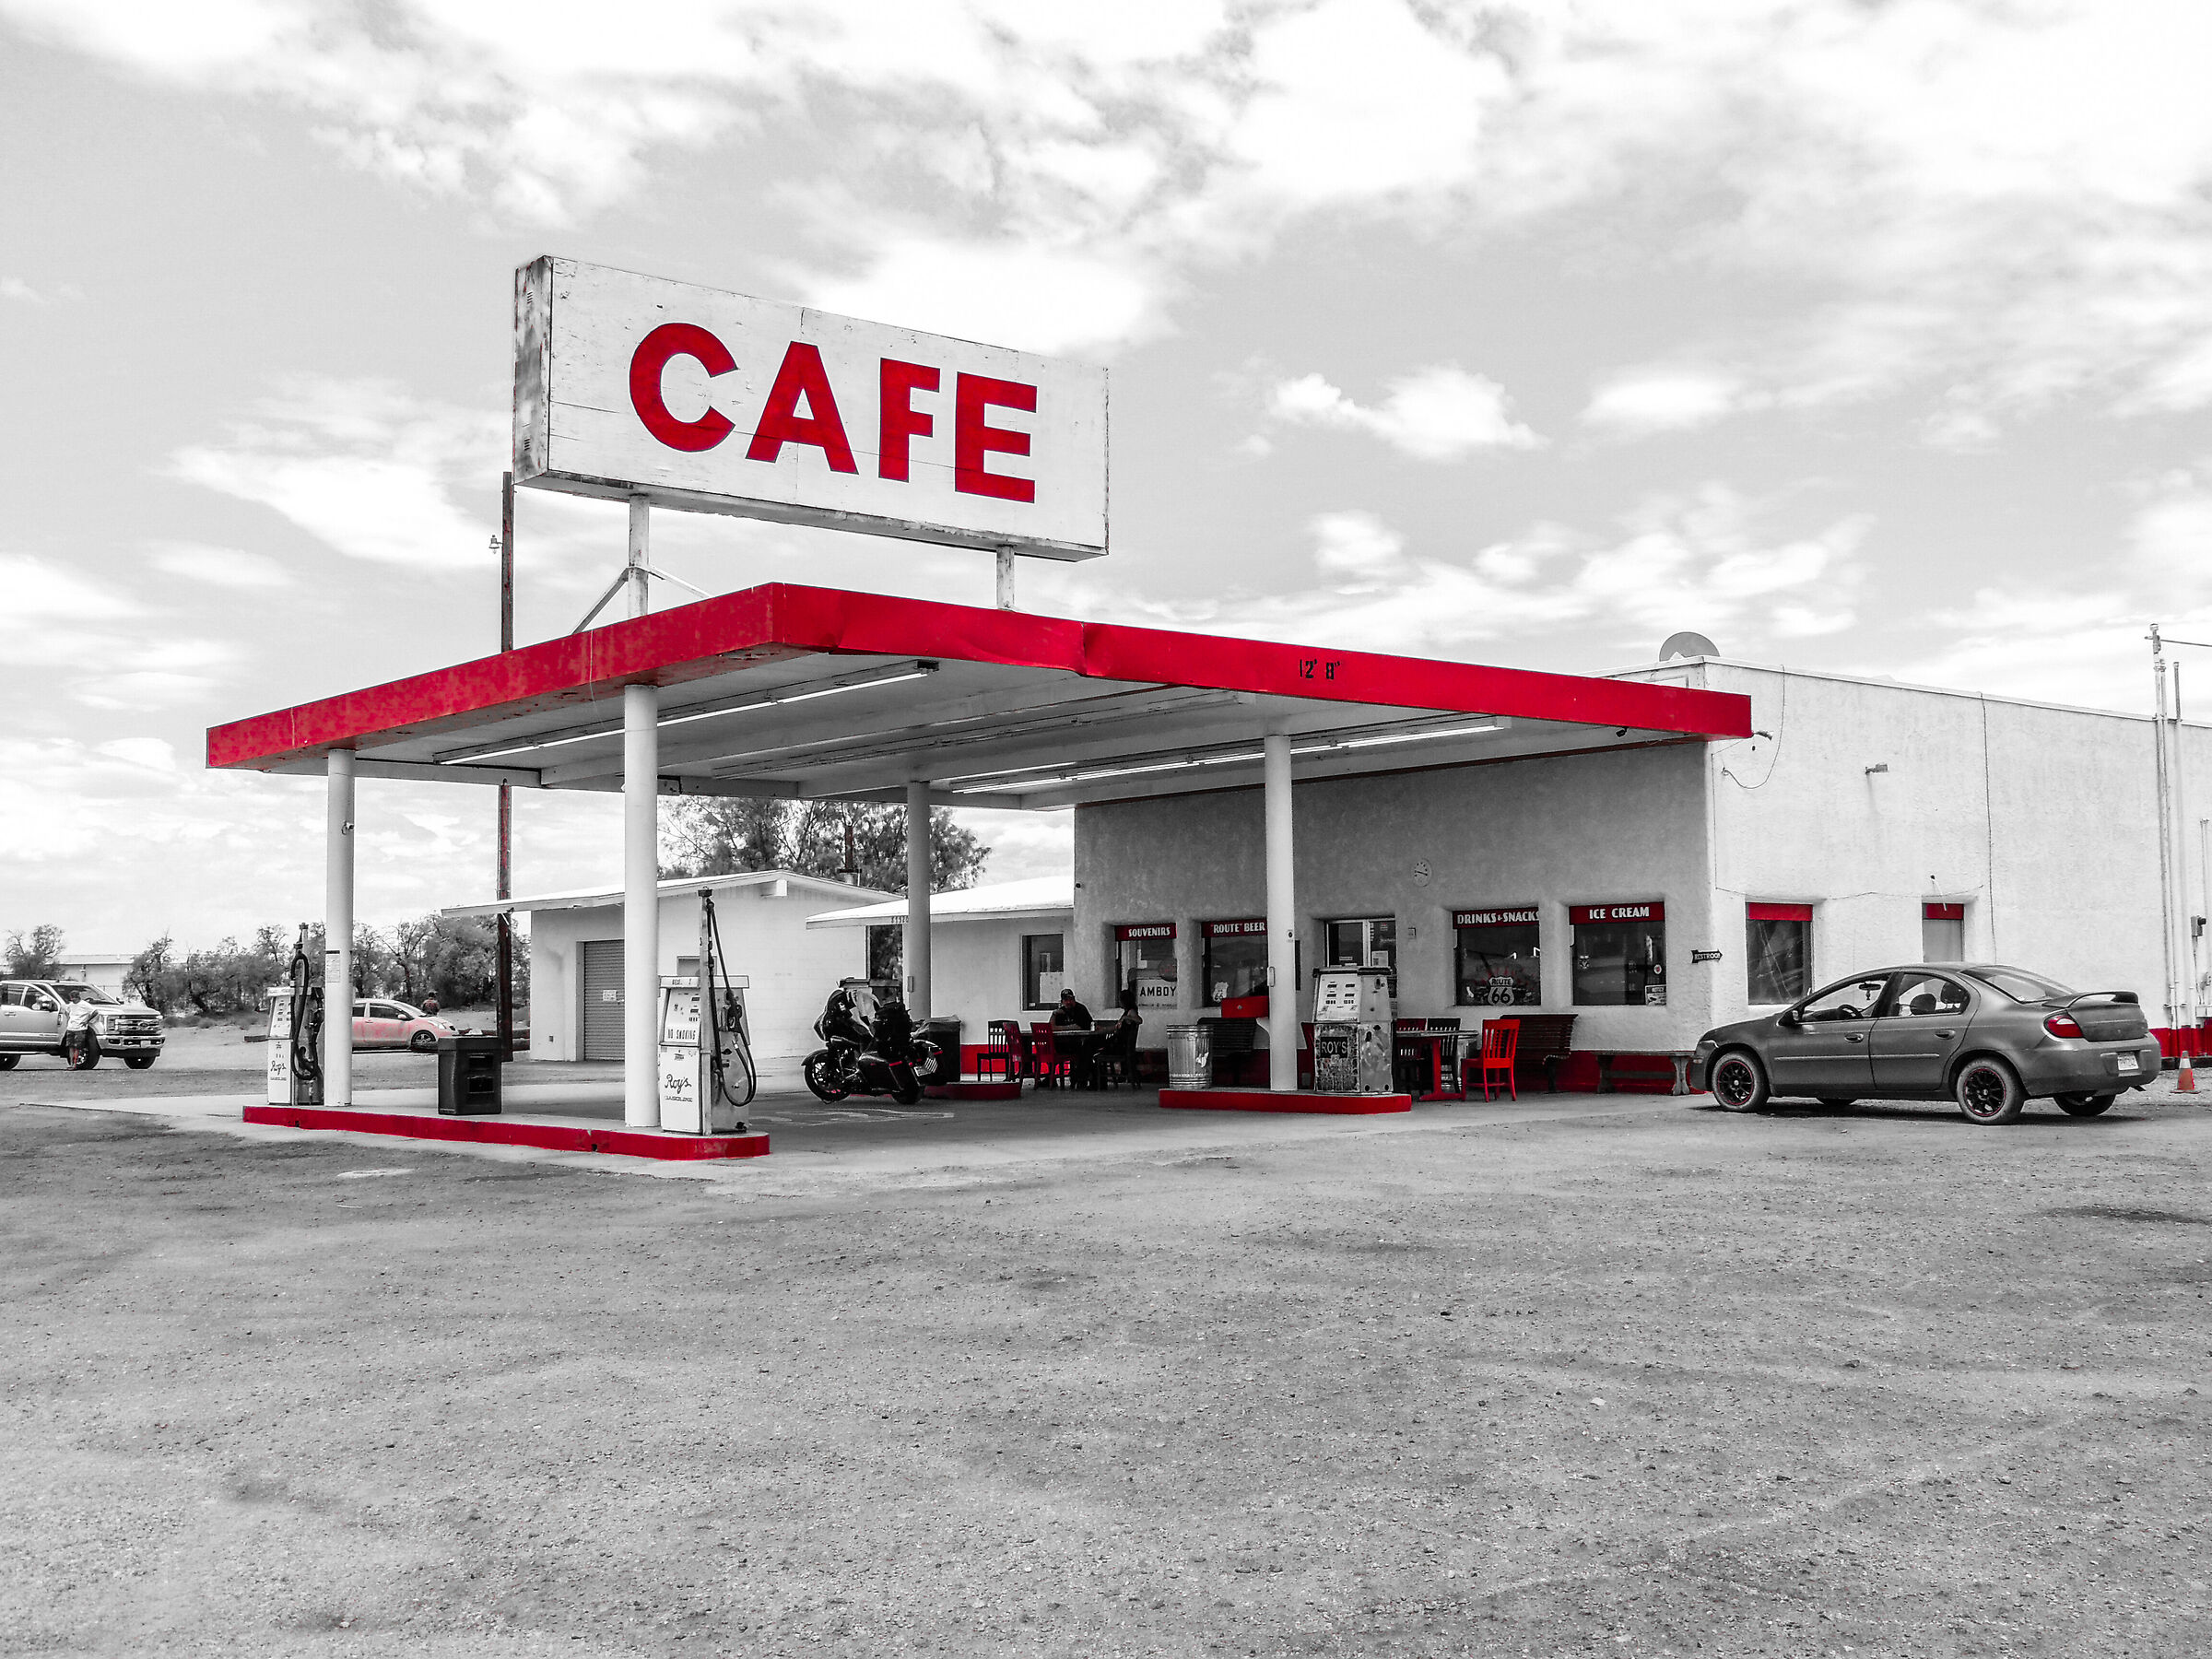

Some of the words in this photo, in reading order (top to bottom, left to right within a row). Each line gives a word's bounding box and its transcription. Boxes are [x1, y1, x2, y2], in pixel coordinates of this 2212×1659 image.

[629, 323, 1038, 504] CAFE
[1457, 912, 1497, 924] DRINKS
[1589, 908, 1606, 920] ICE
[1611, 906, 1650, 919] CREAM
[1128, 926, 1171, 937] SOUVENIRS
[1243, 922, 1265, 932] BEER
[1139, 986, 1177, 997] AMBOY
[1491, 988, 1511, 1005] 66
[1321, 1040, 1347, 1054] ROY'S
[665, 1073, 692, 1094] Roy's
